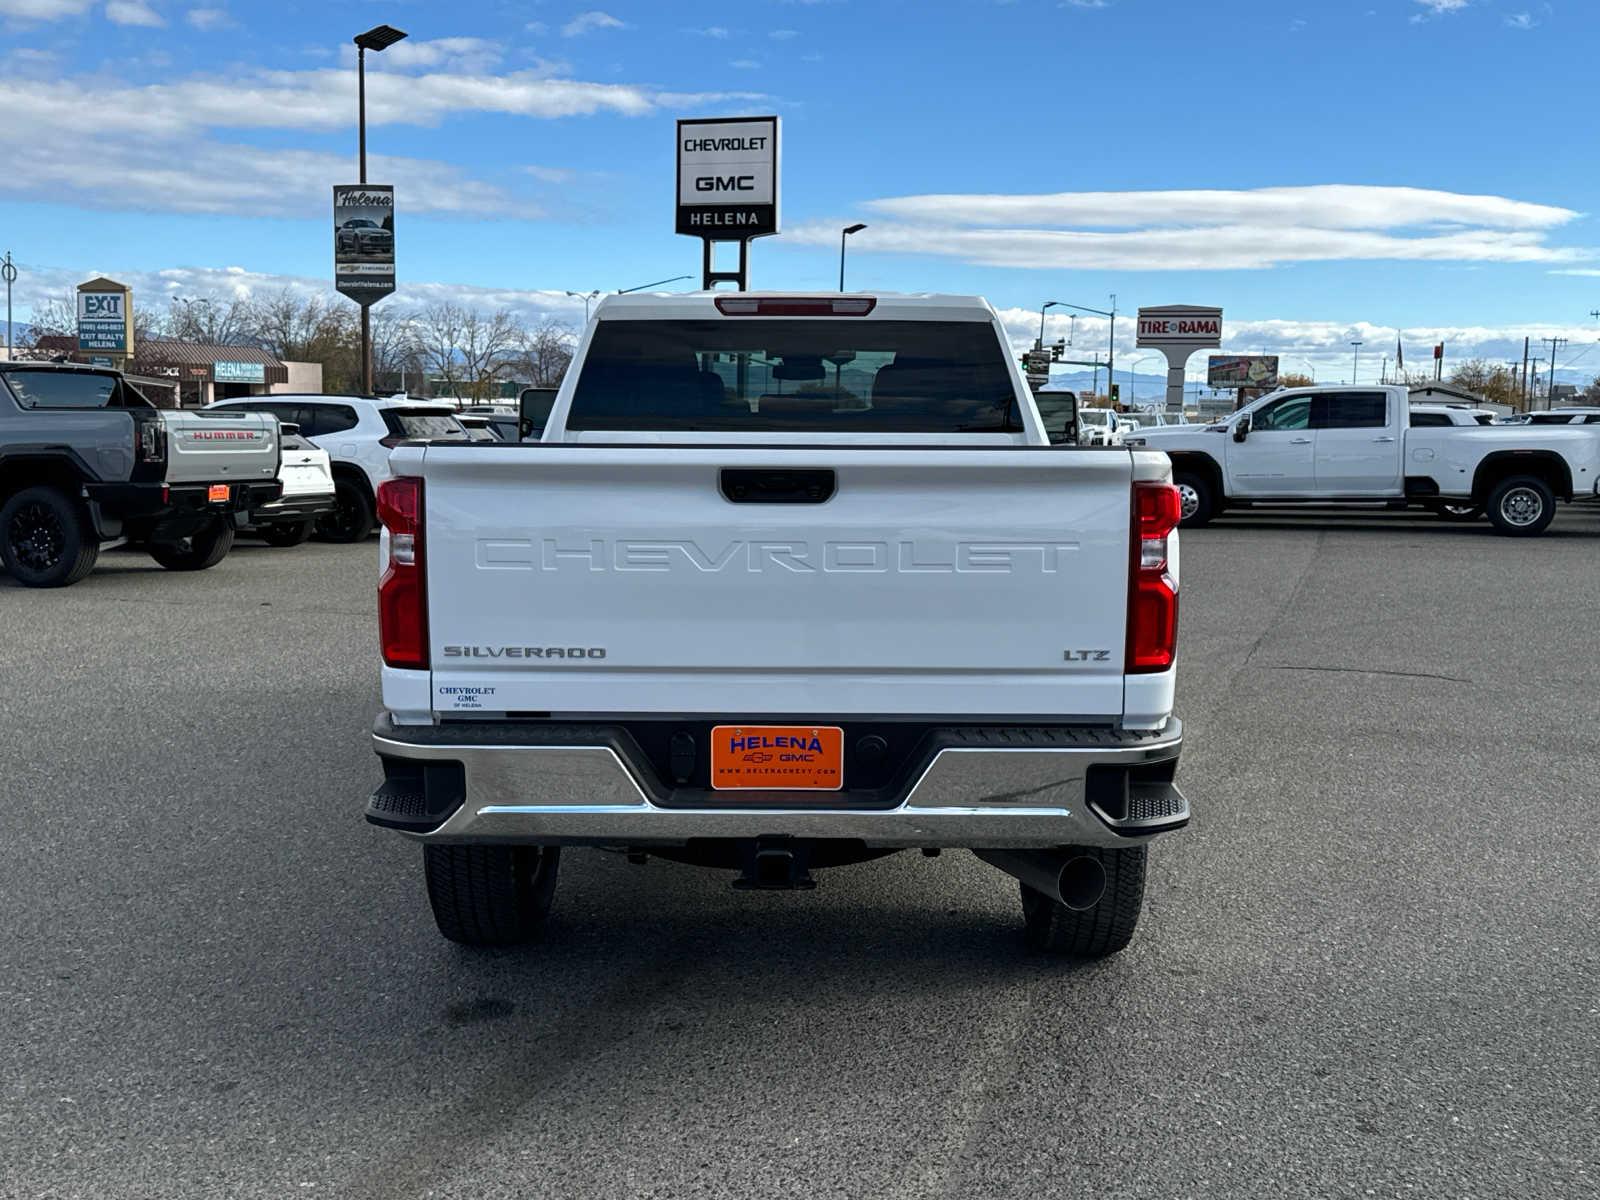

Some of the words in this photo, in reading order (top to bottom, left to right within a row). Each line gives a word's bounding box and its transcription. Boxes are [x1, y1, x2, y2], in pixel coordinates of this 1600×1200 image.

[684, 137, 767, 152] CHEVROLET
[695, 176, 754, 191] GMC
[339, 191, 392, 207] Helena
[690, 212, 759, 225] HELENA
[1140, 321, 1170, 334] TIRE
[1178, 321, 1219, 334] RAMA
[215, 361, 240, 377] HELENA
[193, 432, 254, 440] HUMMER
[475, 538, 1080, 574] CHEVROLET
[443, 646, 607, 659] SILVERADO
[1063, 650, 1111, 661] LTZ
[439, 687, 496, 695] CHEVROLET
[730, 736, 823, 755] HELENA
[779, 754, 815, 762] GMC
